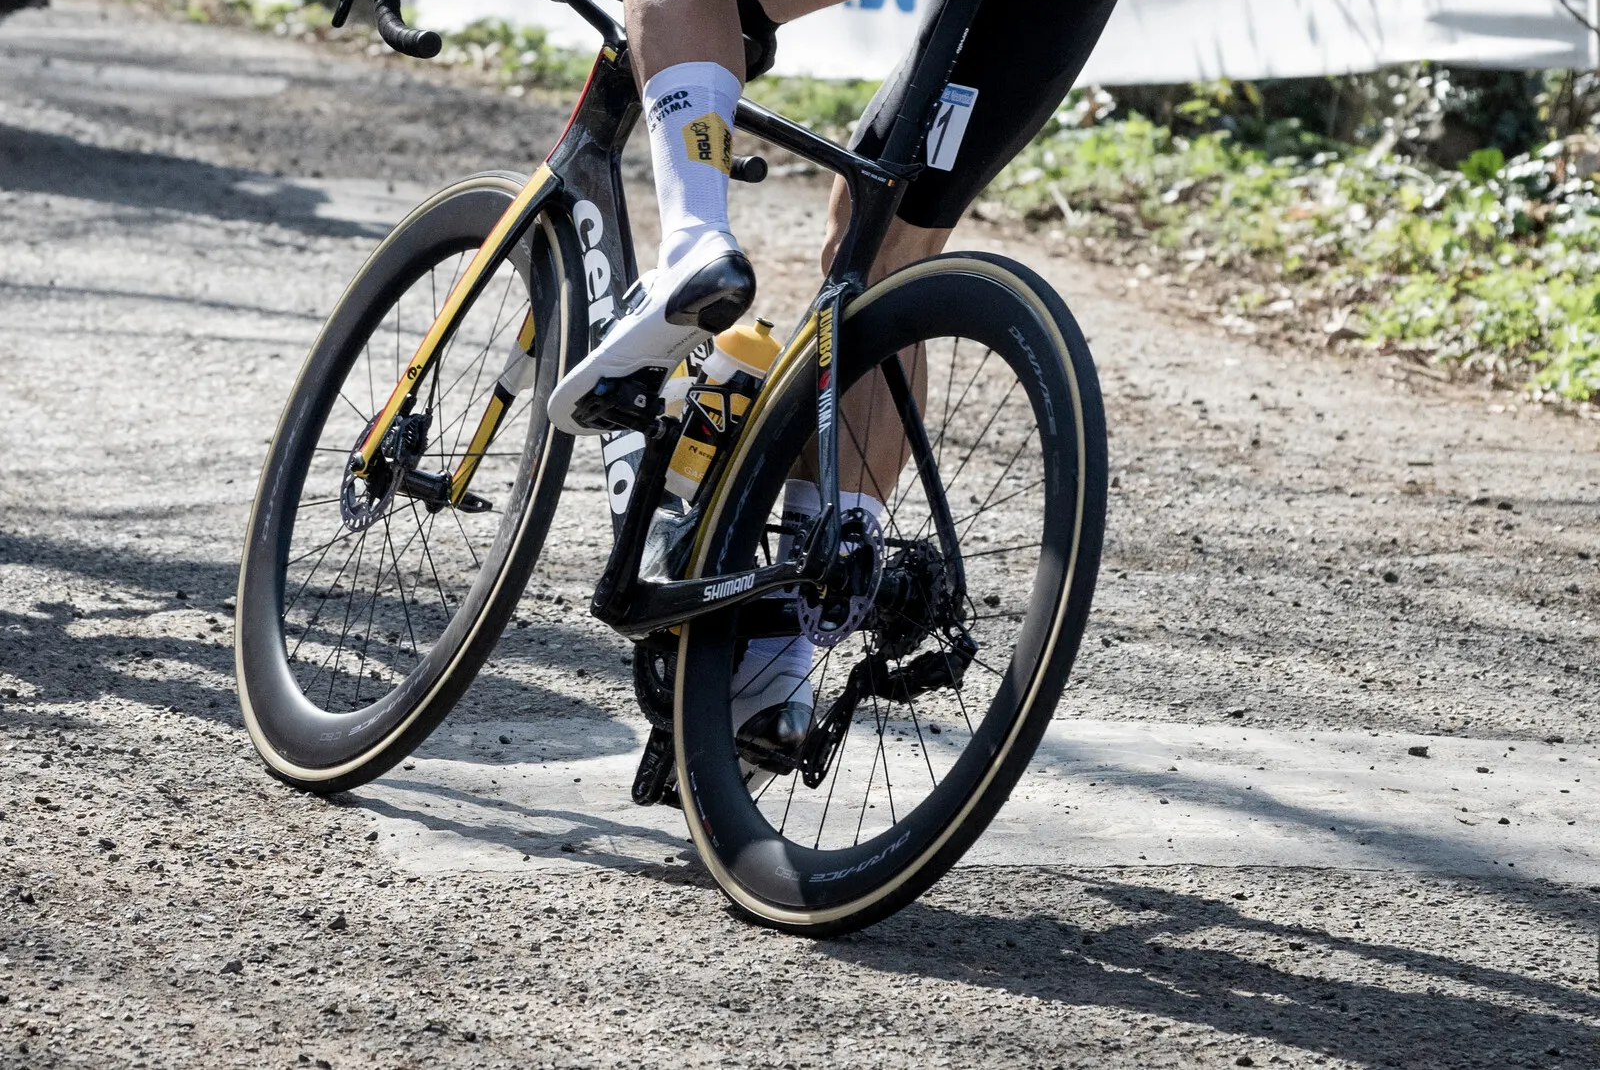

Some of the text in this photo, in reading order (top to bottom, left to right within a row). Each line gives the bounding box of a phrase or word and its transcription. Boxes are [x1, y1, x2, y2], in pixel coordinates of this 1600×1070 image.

[696, 133, 712, 160] AGU
[931, 104, 955, 165] 1
[818, 307, 833, 367] JUMBO
[818, 388, 832, 434] VISMA
[702, 573, 756, 603] SHIMANO
[808, 829, 911, 884] DURA-ACE
